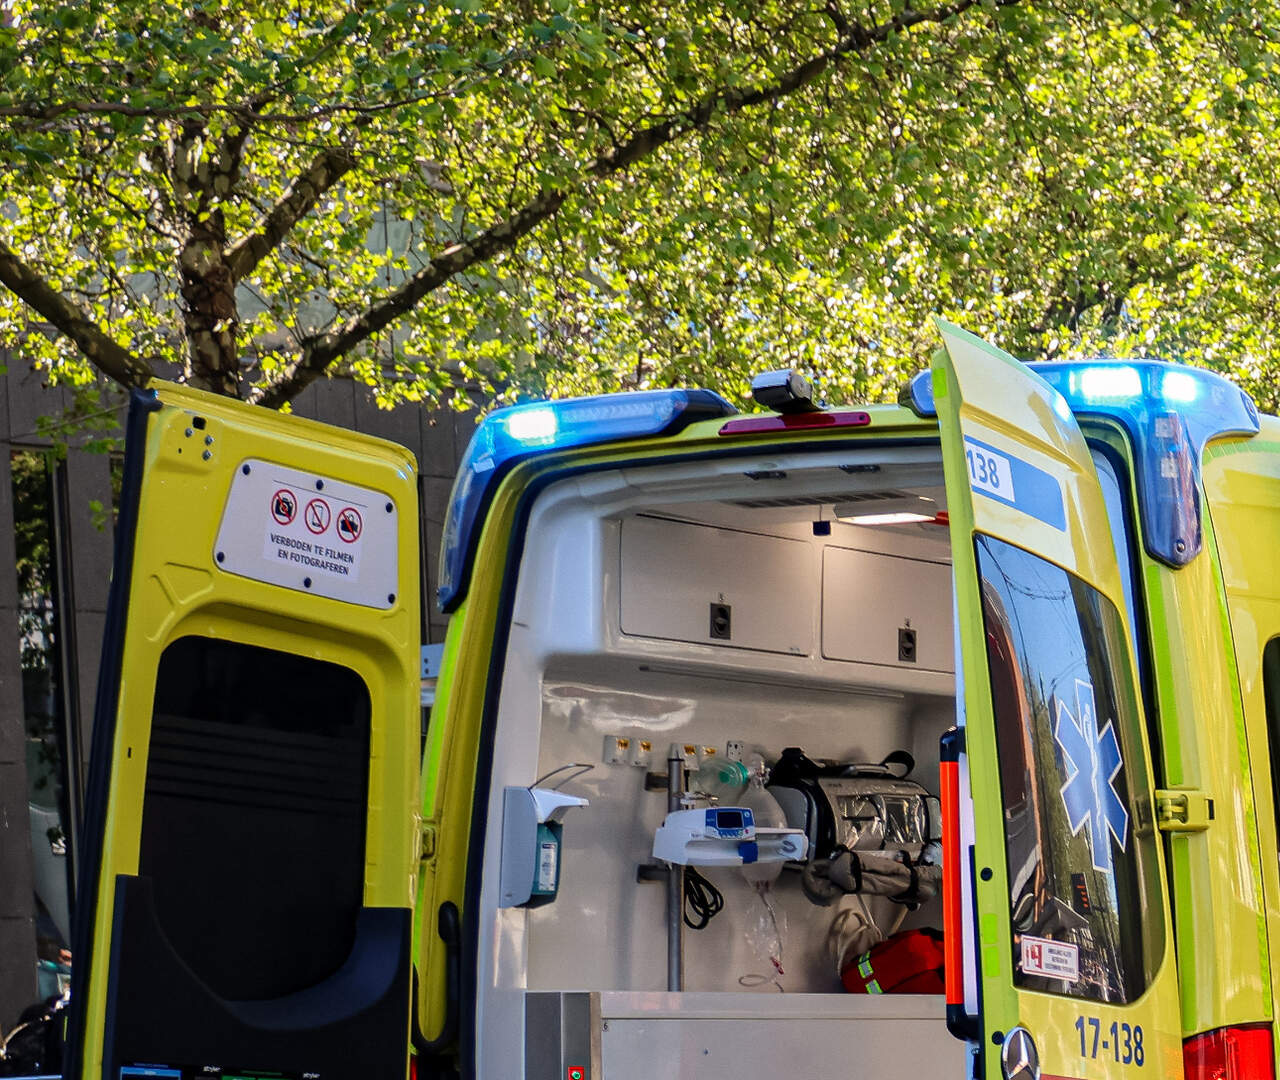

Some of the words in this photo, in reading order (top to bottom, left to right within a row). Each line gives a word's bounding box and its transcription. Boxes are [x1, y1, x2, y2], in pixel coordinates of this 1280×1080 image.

[270, 532, 312, 553] VERBODEN
[314, 544, 324, 556] TE
[325, 547, 354, 564] FILMEN
[278, 549, 289, 560] EN
[290, 551, 349, 575] FOTOGRAFEREN
[1075, 1015, 1144, 1067] 17-138
